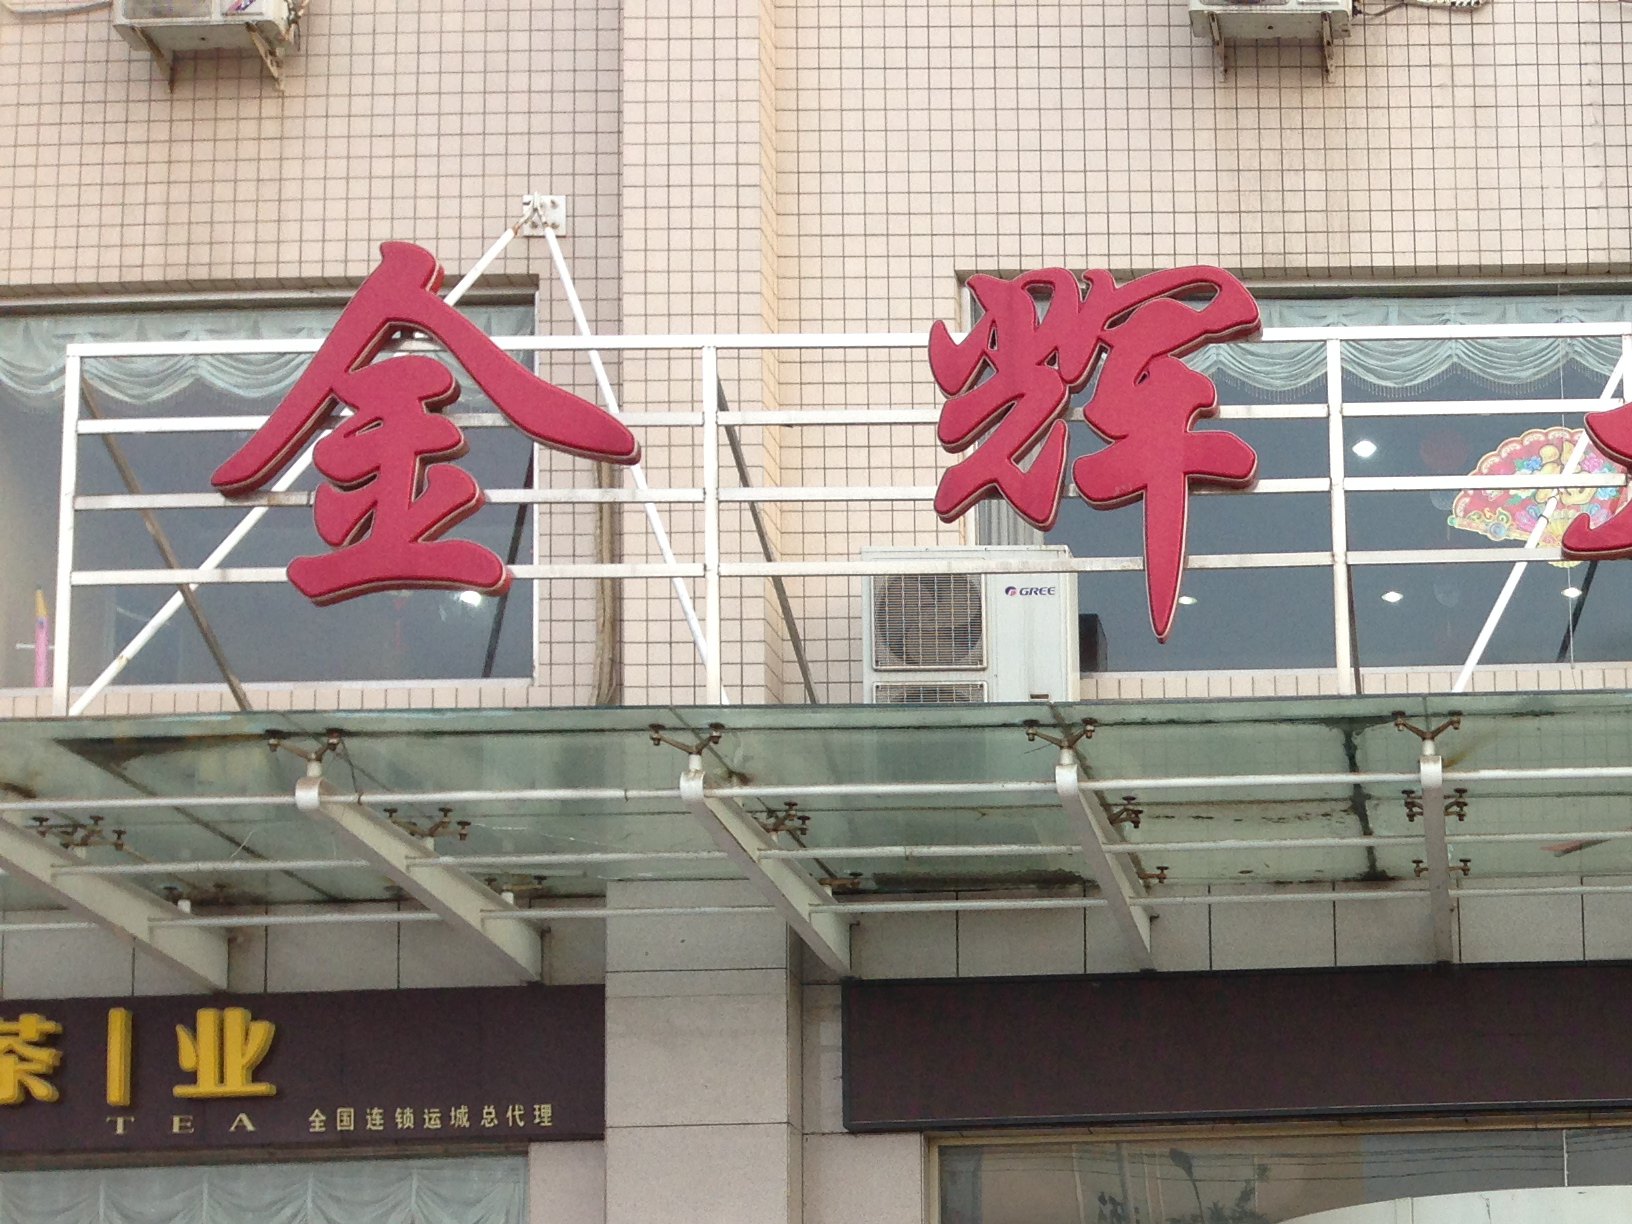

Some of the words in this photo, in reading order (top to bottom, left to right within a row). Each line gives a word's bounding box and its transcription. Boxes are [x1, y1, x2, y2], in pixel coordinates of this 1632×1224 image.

[1019, 585, 1056, 596] GREE
[106, 1112, 257, 1136] TEA
[308, 1103, 553, 1133] 全国连锁运城总代理
